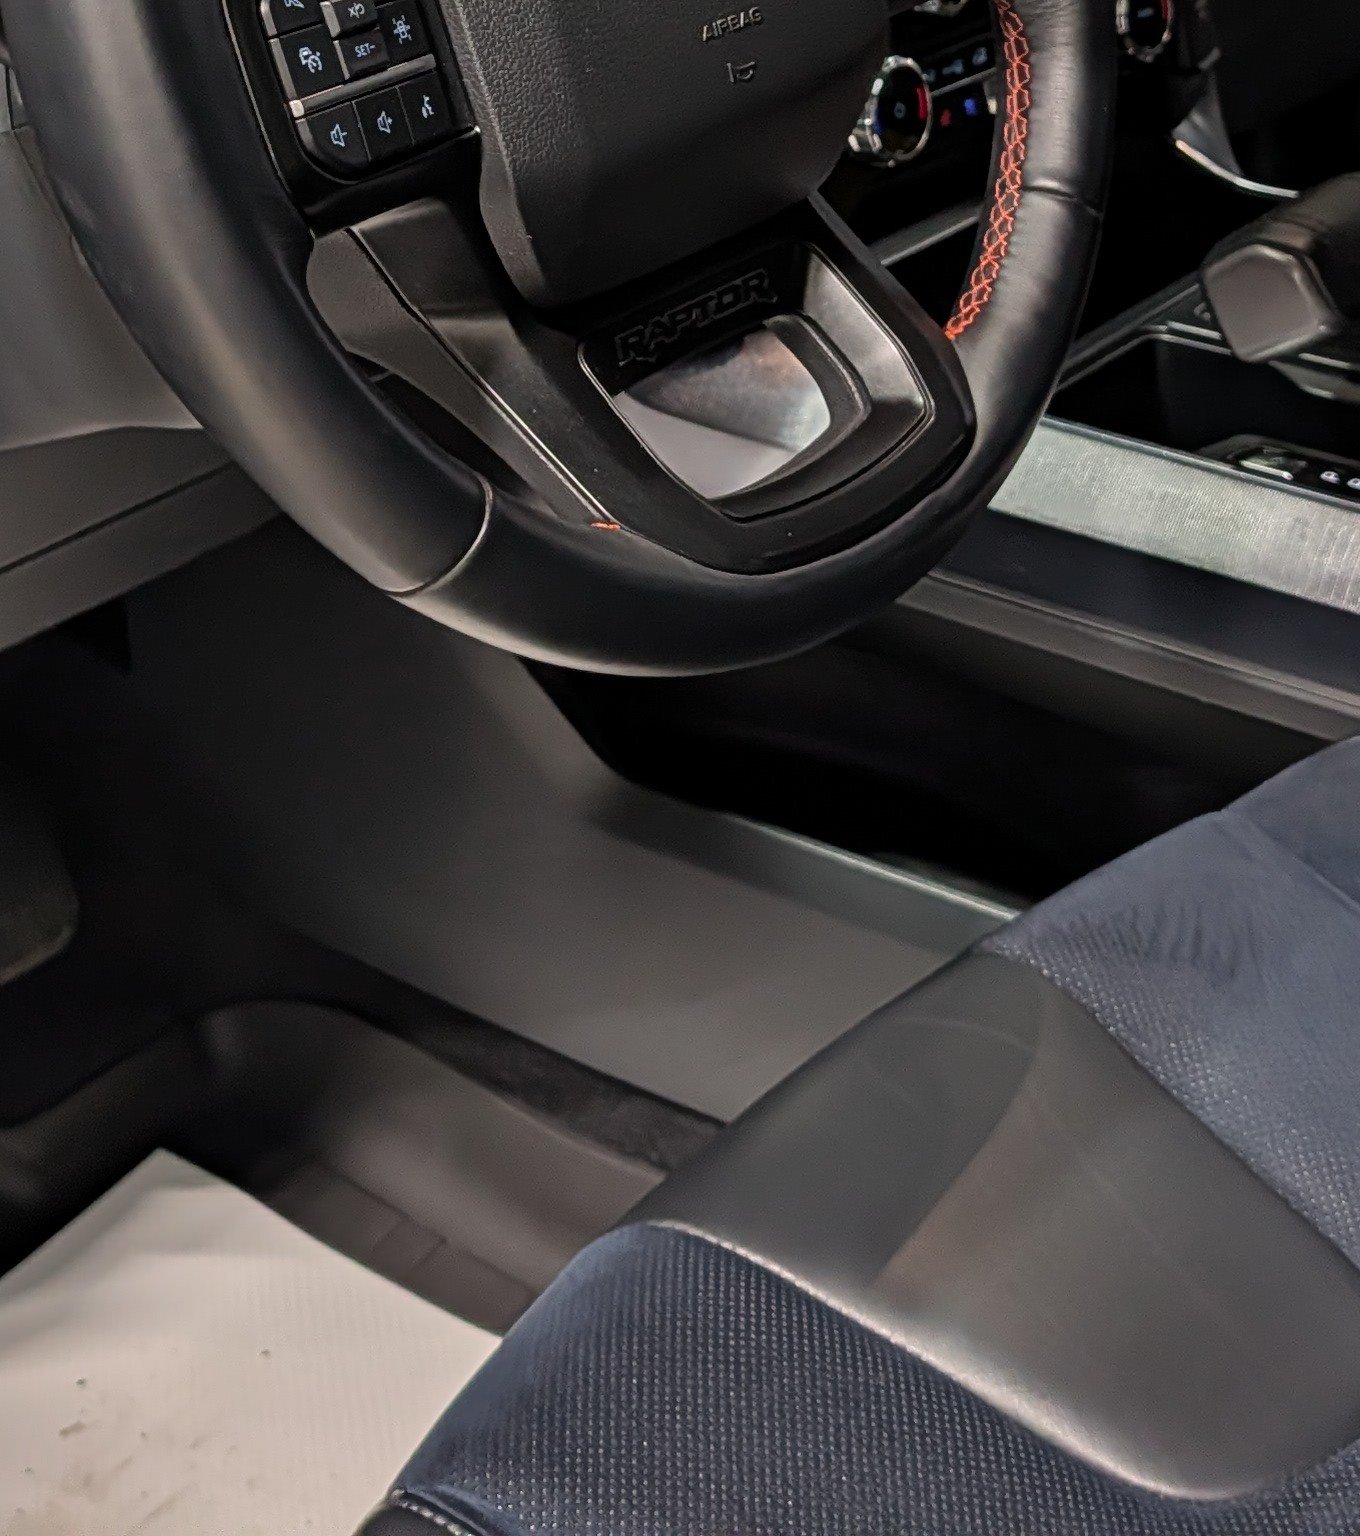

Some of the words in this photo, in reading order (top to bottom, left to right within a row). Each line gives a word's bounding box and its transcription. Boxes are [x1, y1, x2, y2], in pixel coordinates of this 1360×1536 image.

[701, 6, 763, 42] AIRBAG
[354, 42, 376, 58] SET-
[614, 268, 778, 367] RAPTOR
[1320, 470, 1340, 484] P
